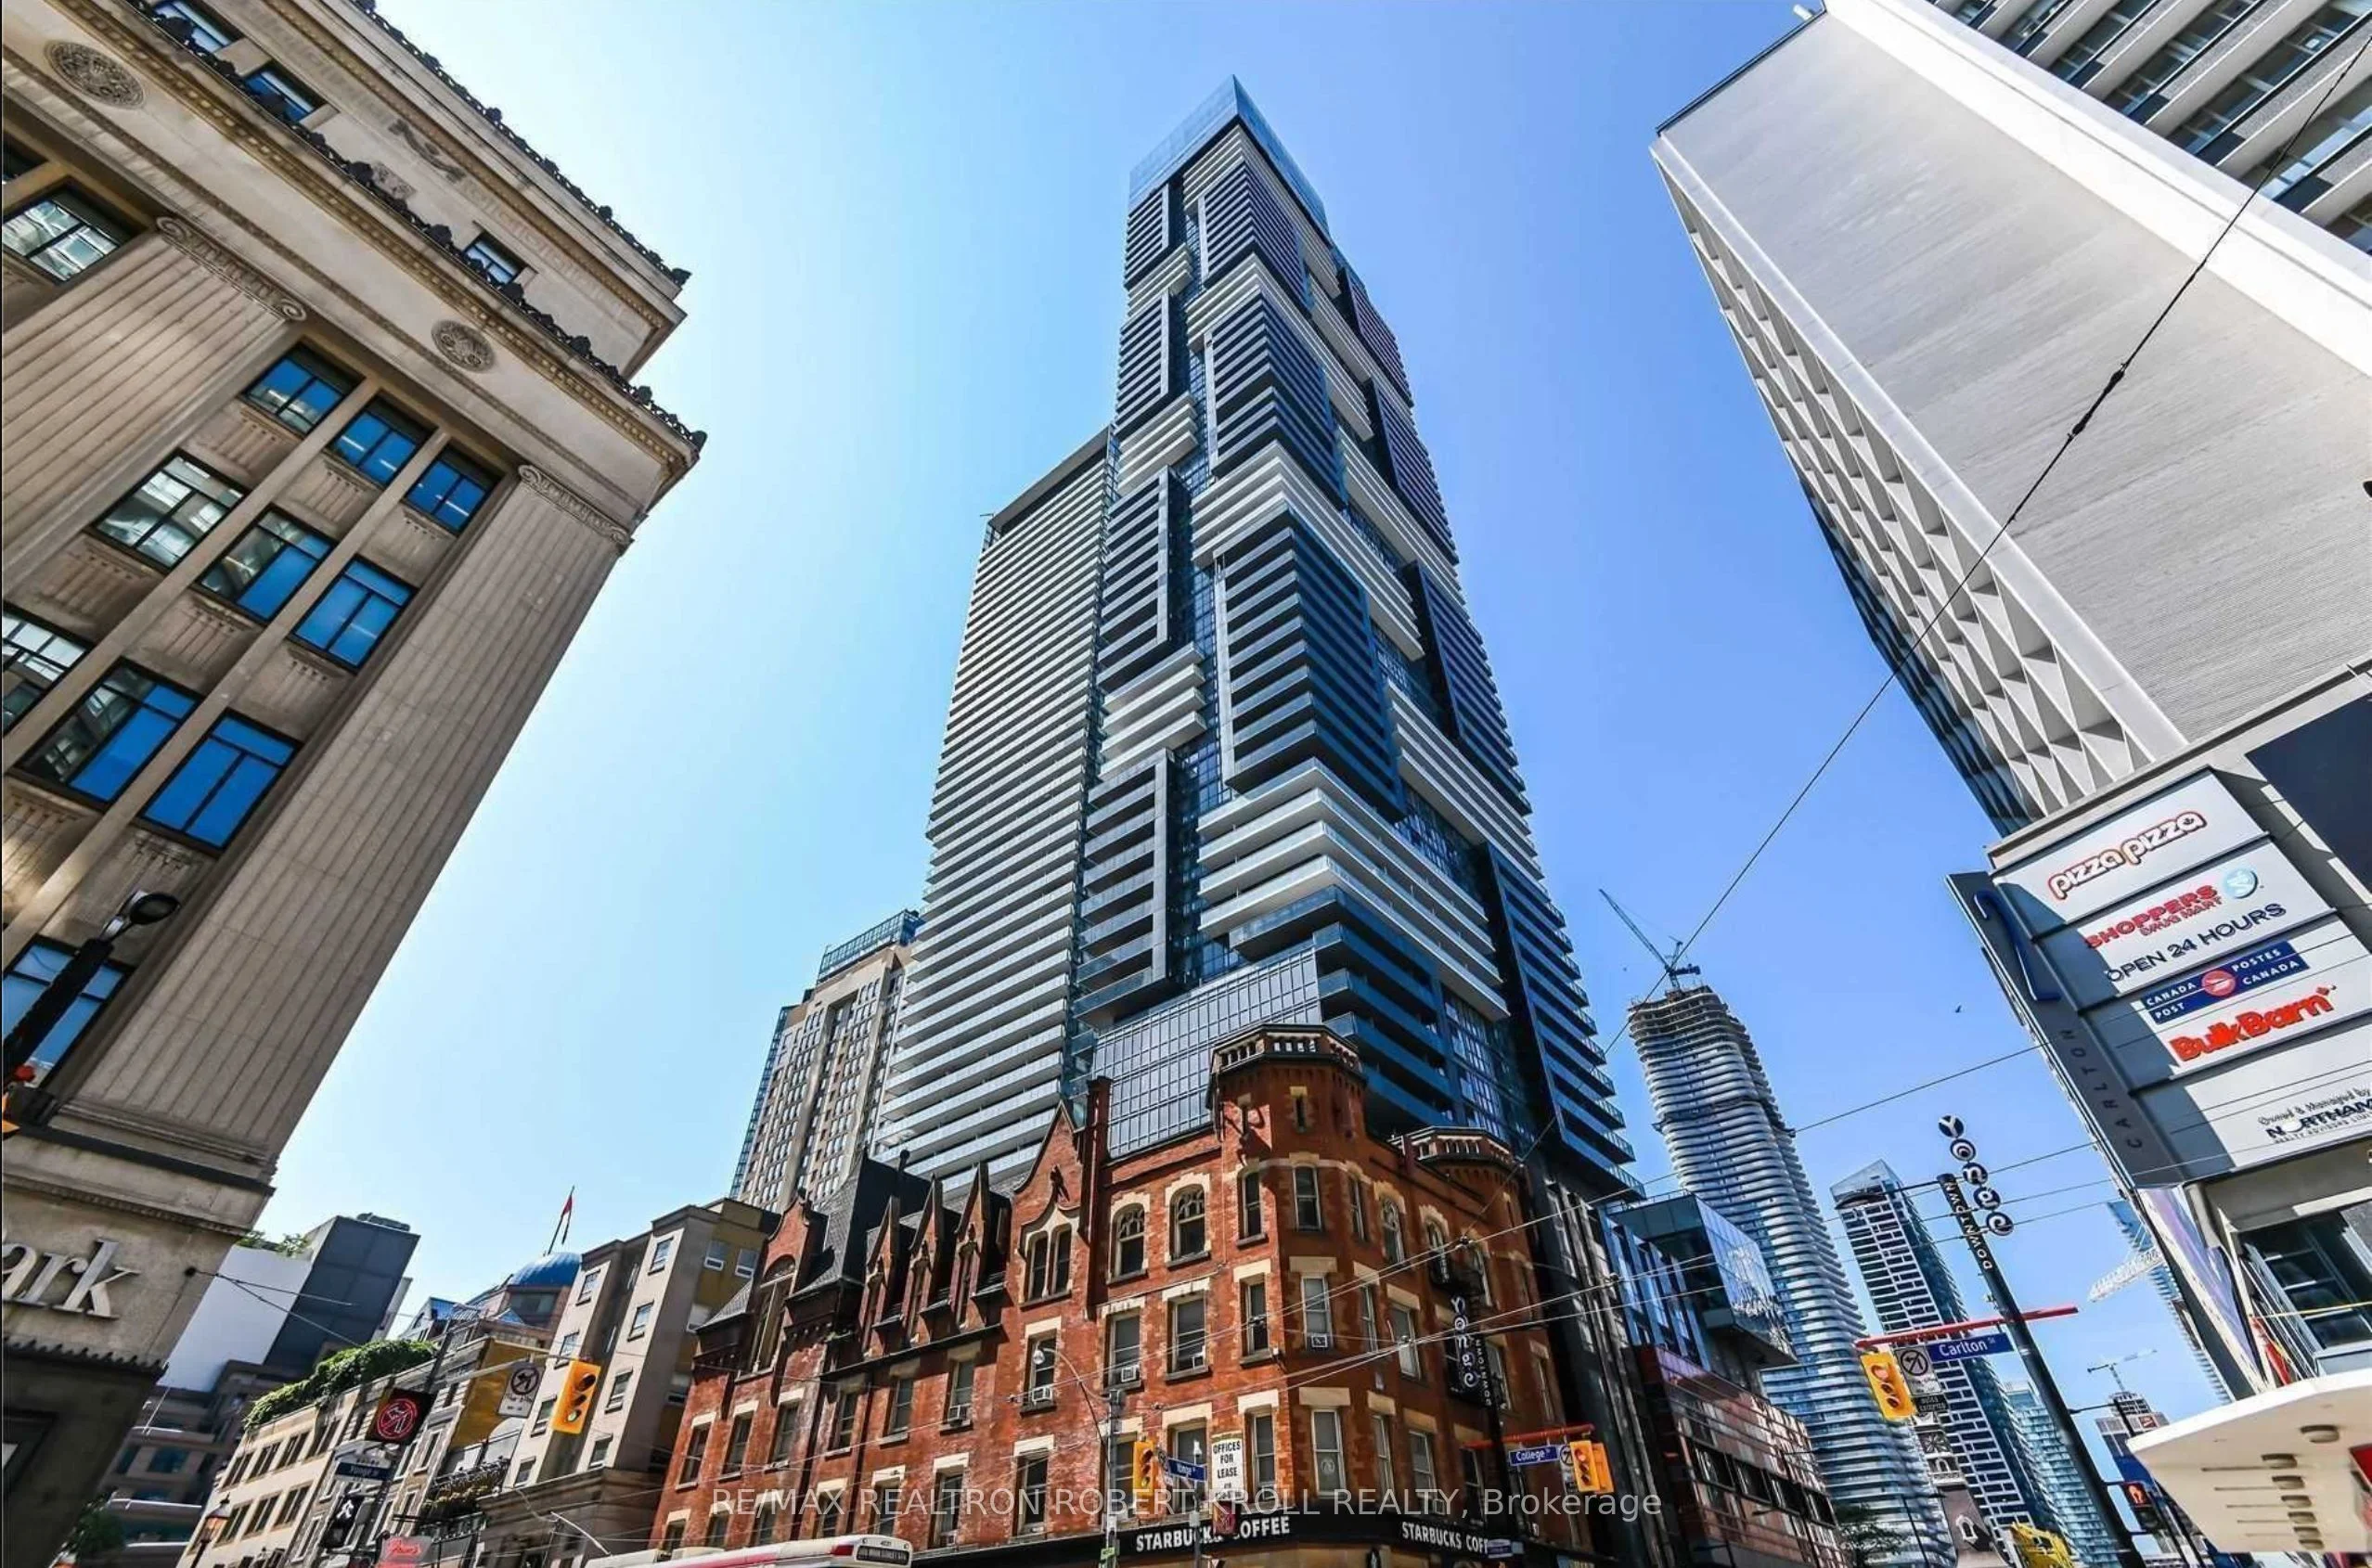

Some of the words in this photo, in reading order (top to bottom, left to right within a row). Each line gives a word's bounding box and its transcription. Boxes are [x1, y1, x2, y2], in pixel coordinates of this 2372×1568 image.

[2085, 884, 2219, 948] SHOPPERS
[2140, 915, 2181, 936] DRUG
[2182, 896, 2224, 919] MART
[2107, 950, 2167, 982] OPEN
[2167, 938, 2198, 958] 24
[2198, 903, 2287, 945] HOURS
[2146, 982, 2198, 1006] CANADA
[2232, 949, 2282, 972] POSTES
[2155, 1002, 2185, 1019] POST
[2242, 960, 2300, 985] CANADA
[2059, 1029, 2143, 1149] CARLTON
[1944, 1181, 1992, 1270] DOWNTOWN
[2, 1237, 142, 1319] ark
[1939, 1339, 1988, 1356] Carlton
[1213, 1441, 1241, 1454] OFFICES
[1220, 1453, 1233, 1464] FOR
[1516, 1450, 1545, 1461] College
[1217, 1467, 1238, 1479] LEASE
[1402, 1521, 1463, 1550] STARBUCKS
